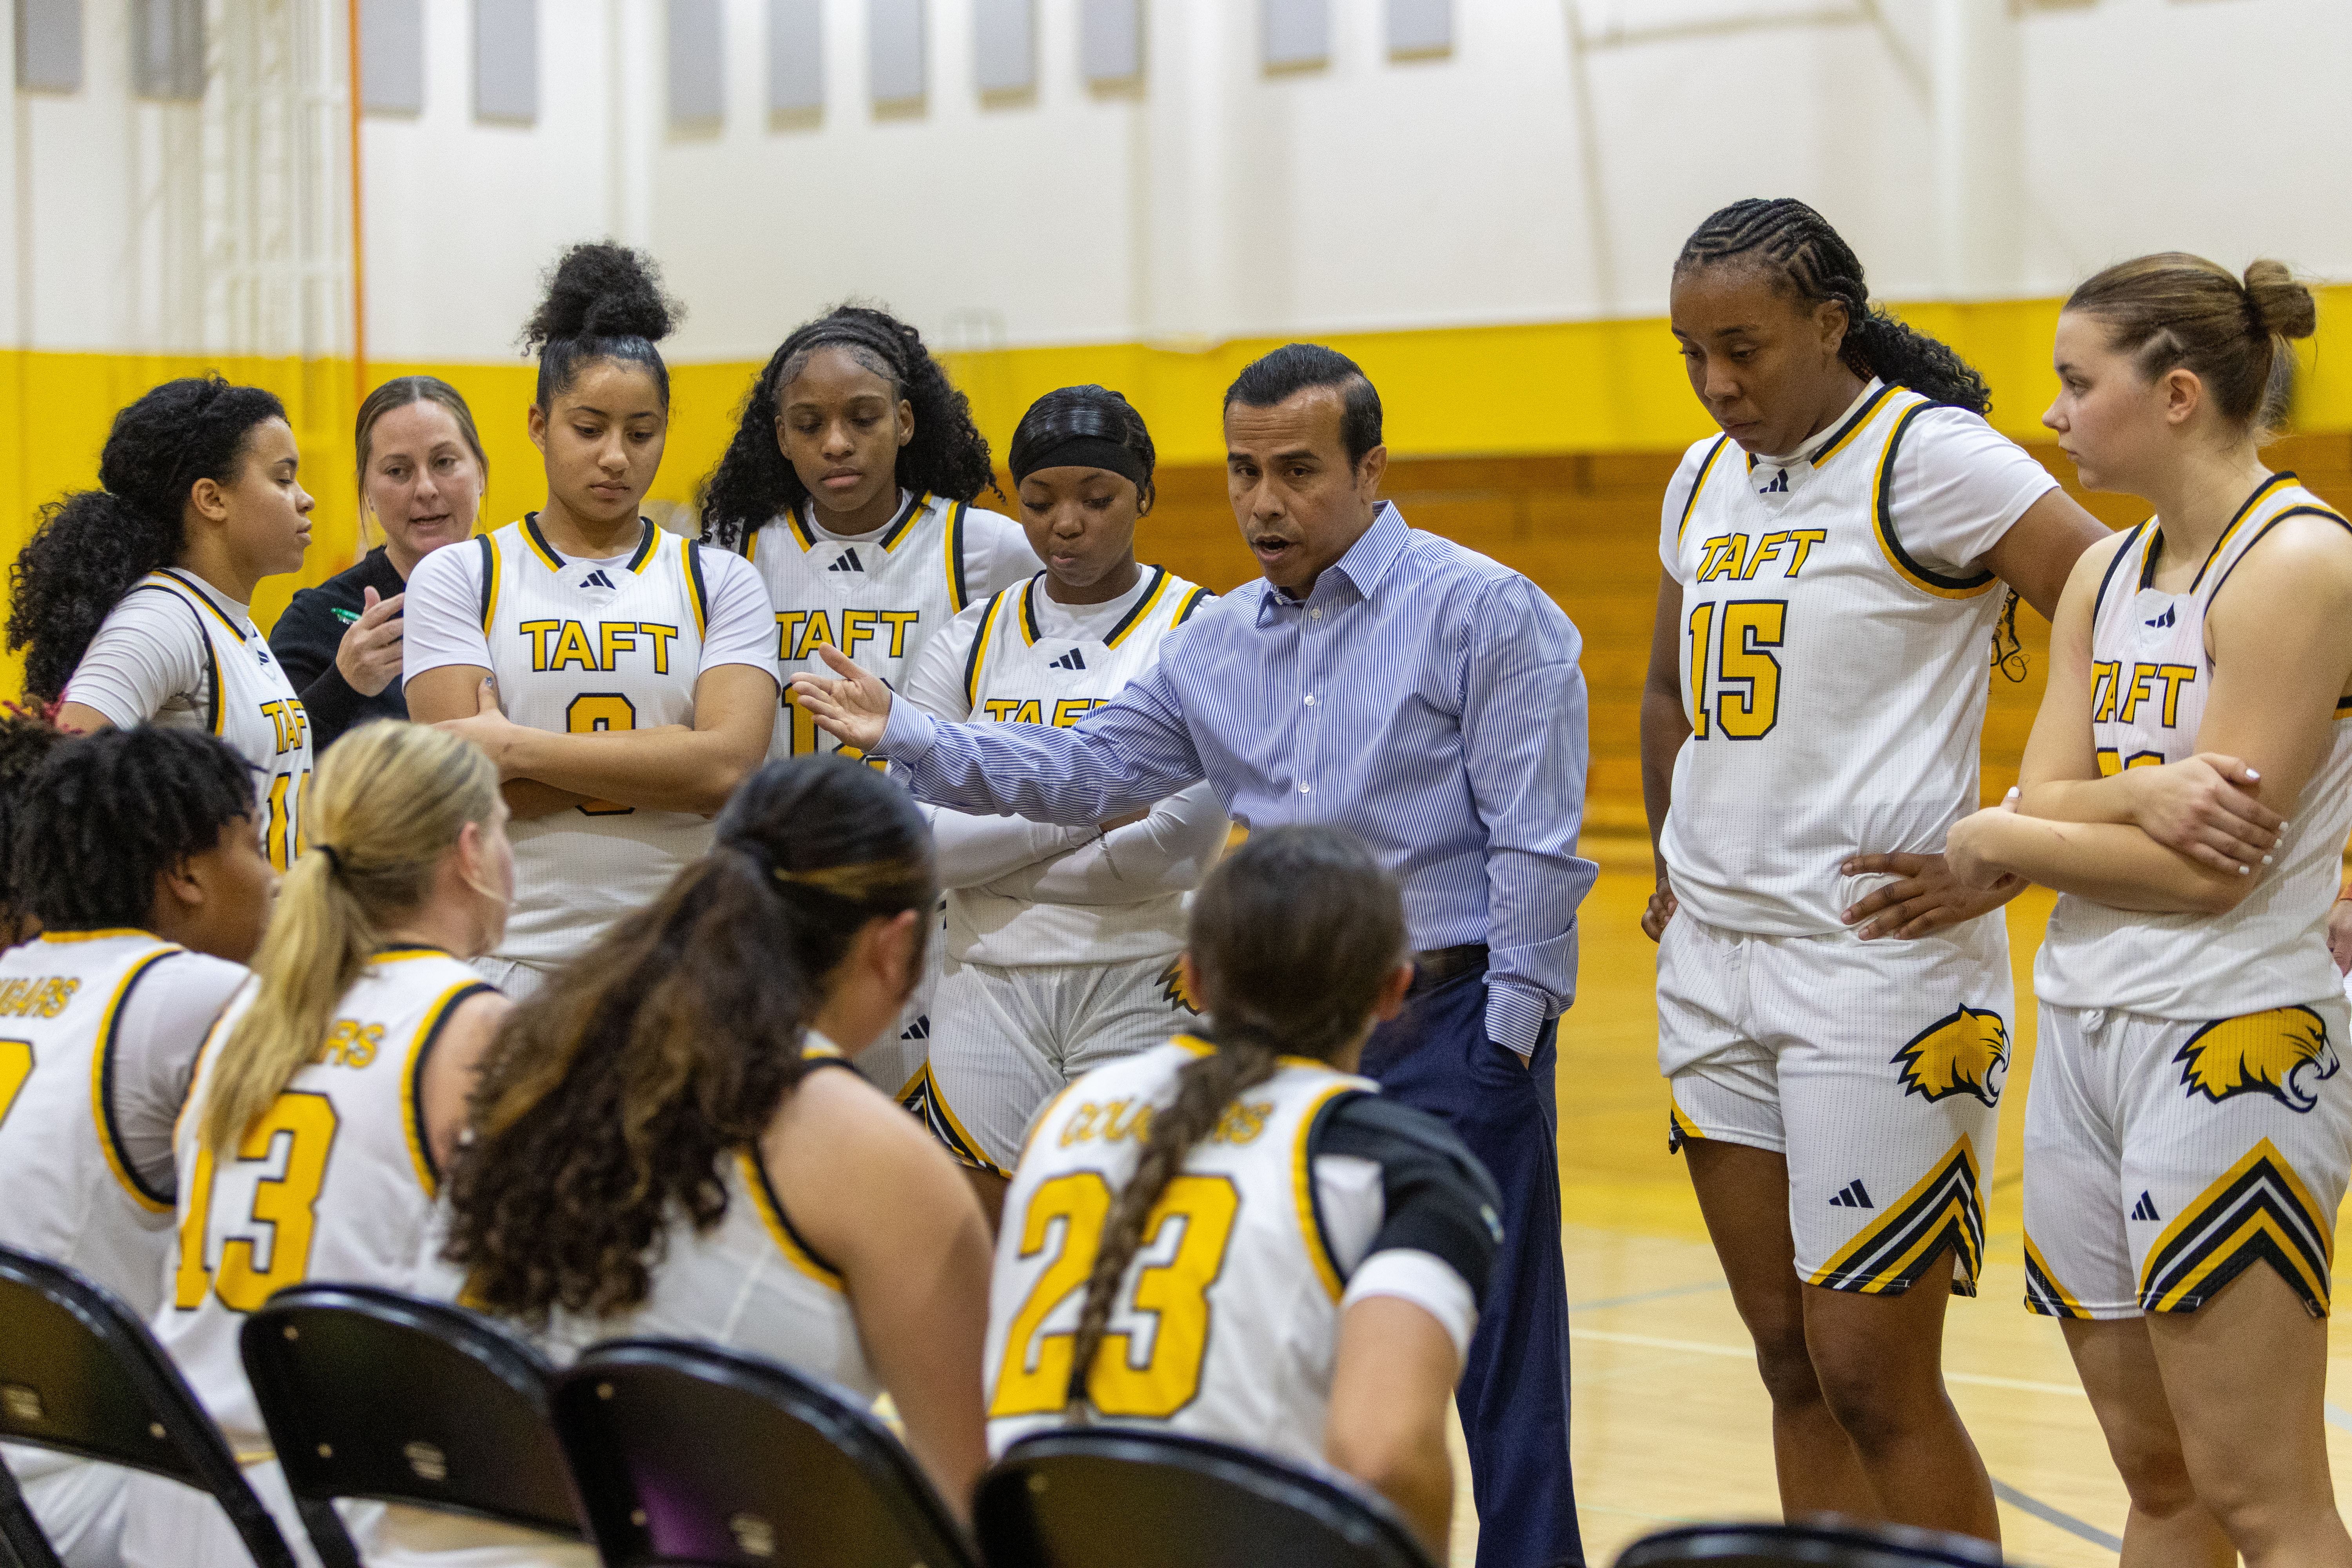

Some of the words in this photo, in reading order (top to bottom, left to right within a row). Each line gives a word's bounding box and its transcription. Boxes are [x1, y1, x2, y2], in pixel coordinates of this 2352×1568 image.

[1696, 528, 1828, 585] TAFT
[519, 619, 678, 675] TAFT
[775, 608, 920, 661] TAFT
[1688, 599, 1789, 741] 15
[2091, 660, 2197, 729] TAFT
[260, 698, 307, 755] TAF
[984, 699, 1111, 728] TAF
[175, 1090, 340, 1312] 13
[988, 1170, 1241, 1419] 23
